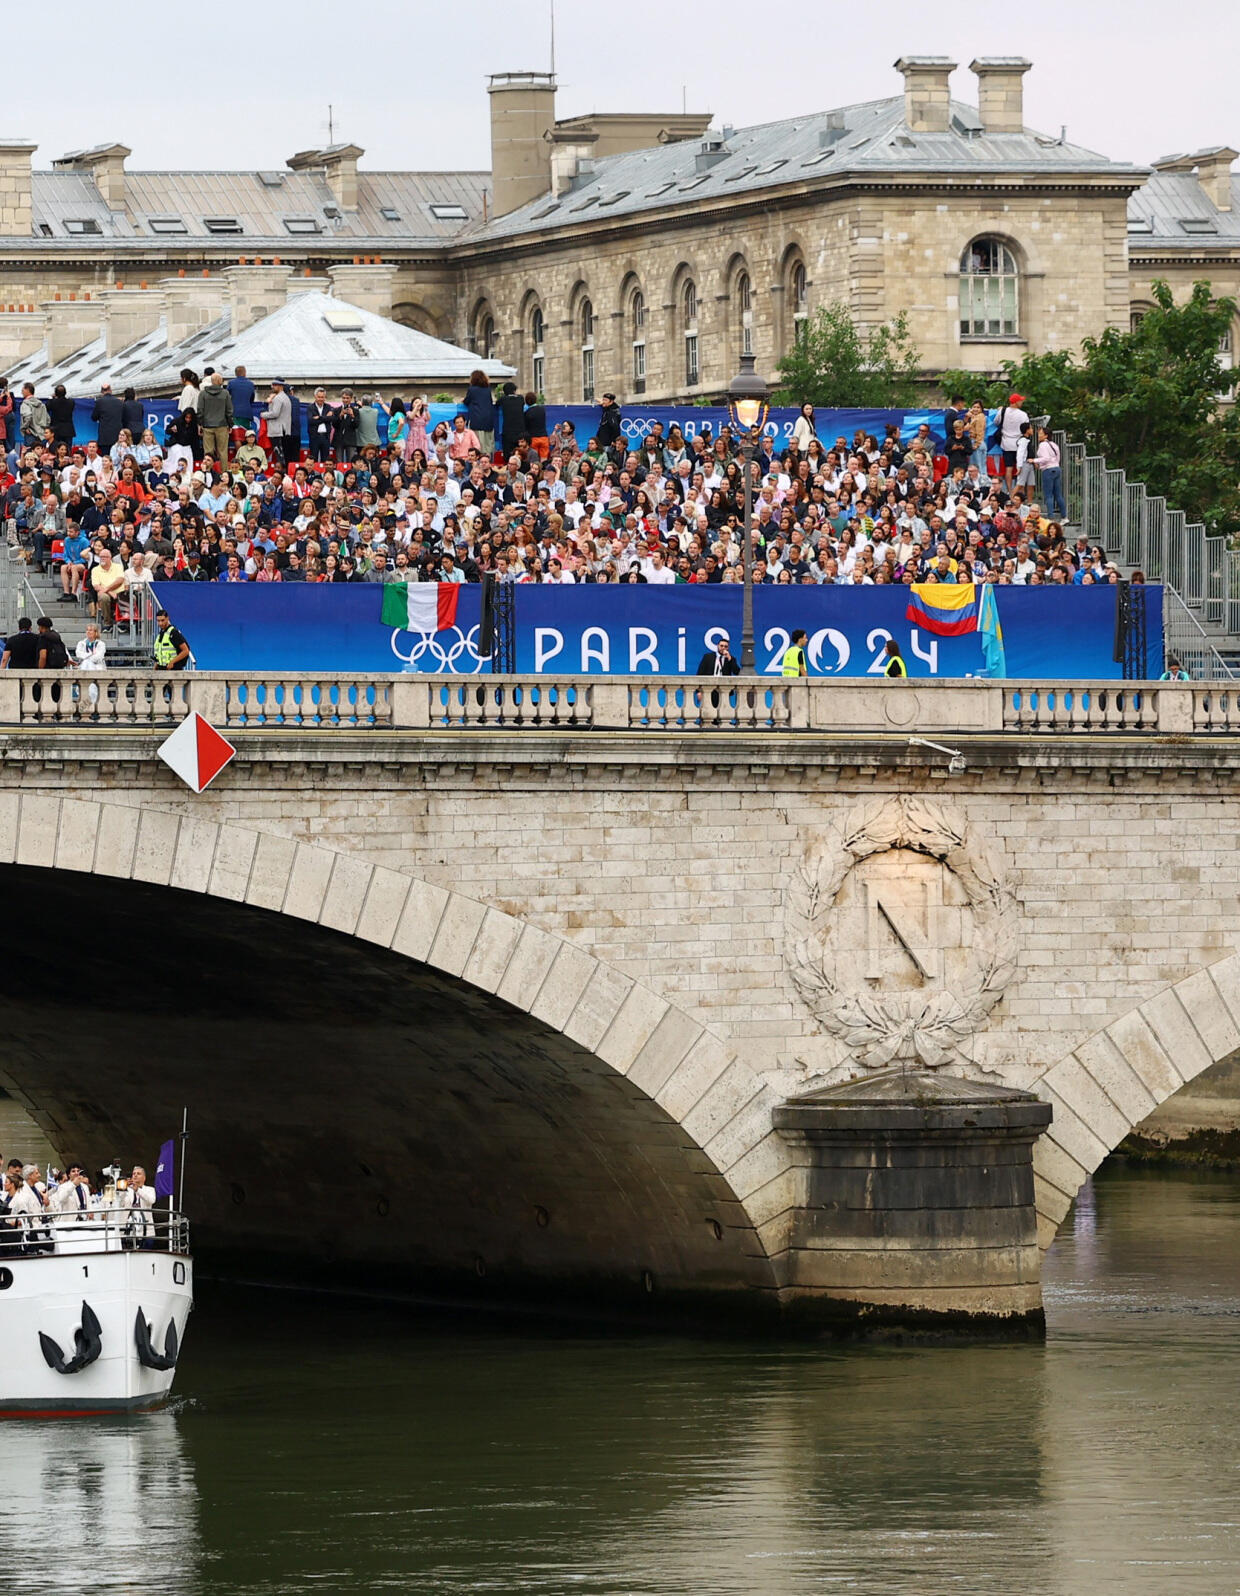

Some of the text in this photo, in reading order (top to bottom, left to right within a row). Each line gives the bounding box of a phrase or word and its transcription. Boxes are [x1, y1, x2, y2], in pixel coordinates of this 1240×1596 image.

[763, 626, 938, 674] 2024
[861, 882, 940, 980] N
[82, 1265, 89, 1278] 1
[151, 1263, 156, 1275] 1
